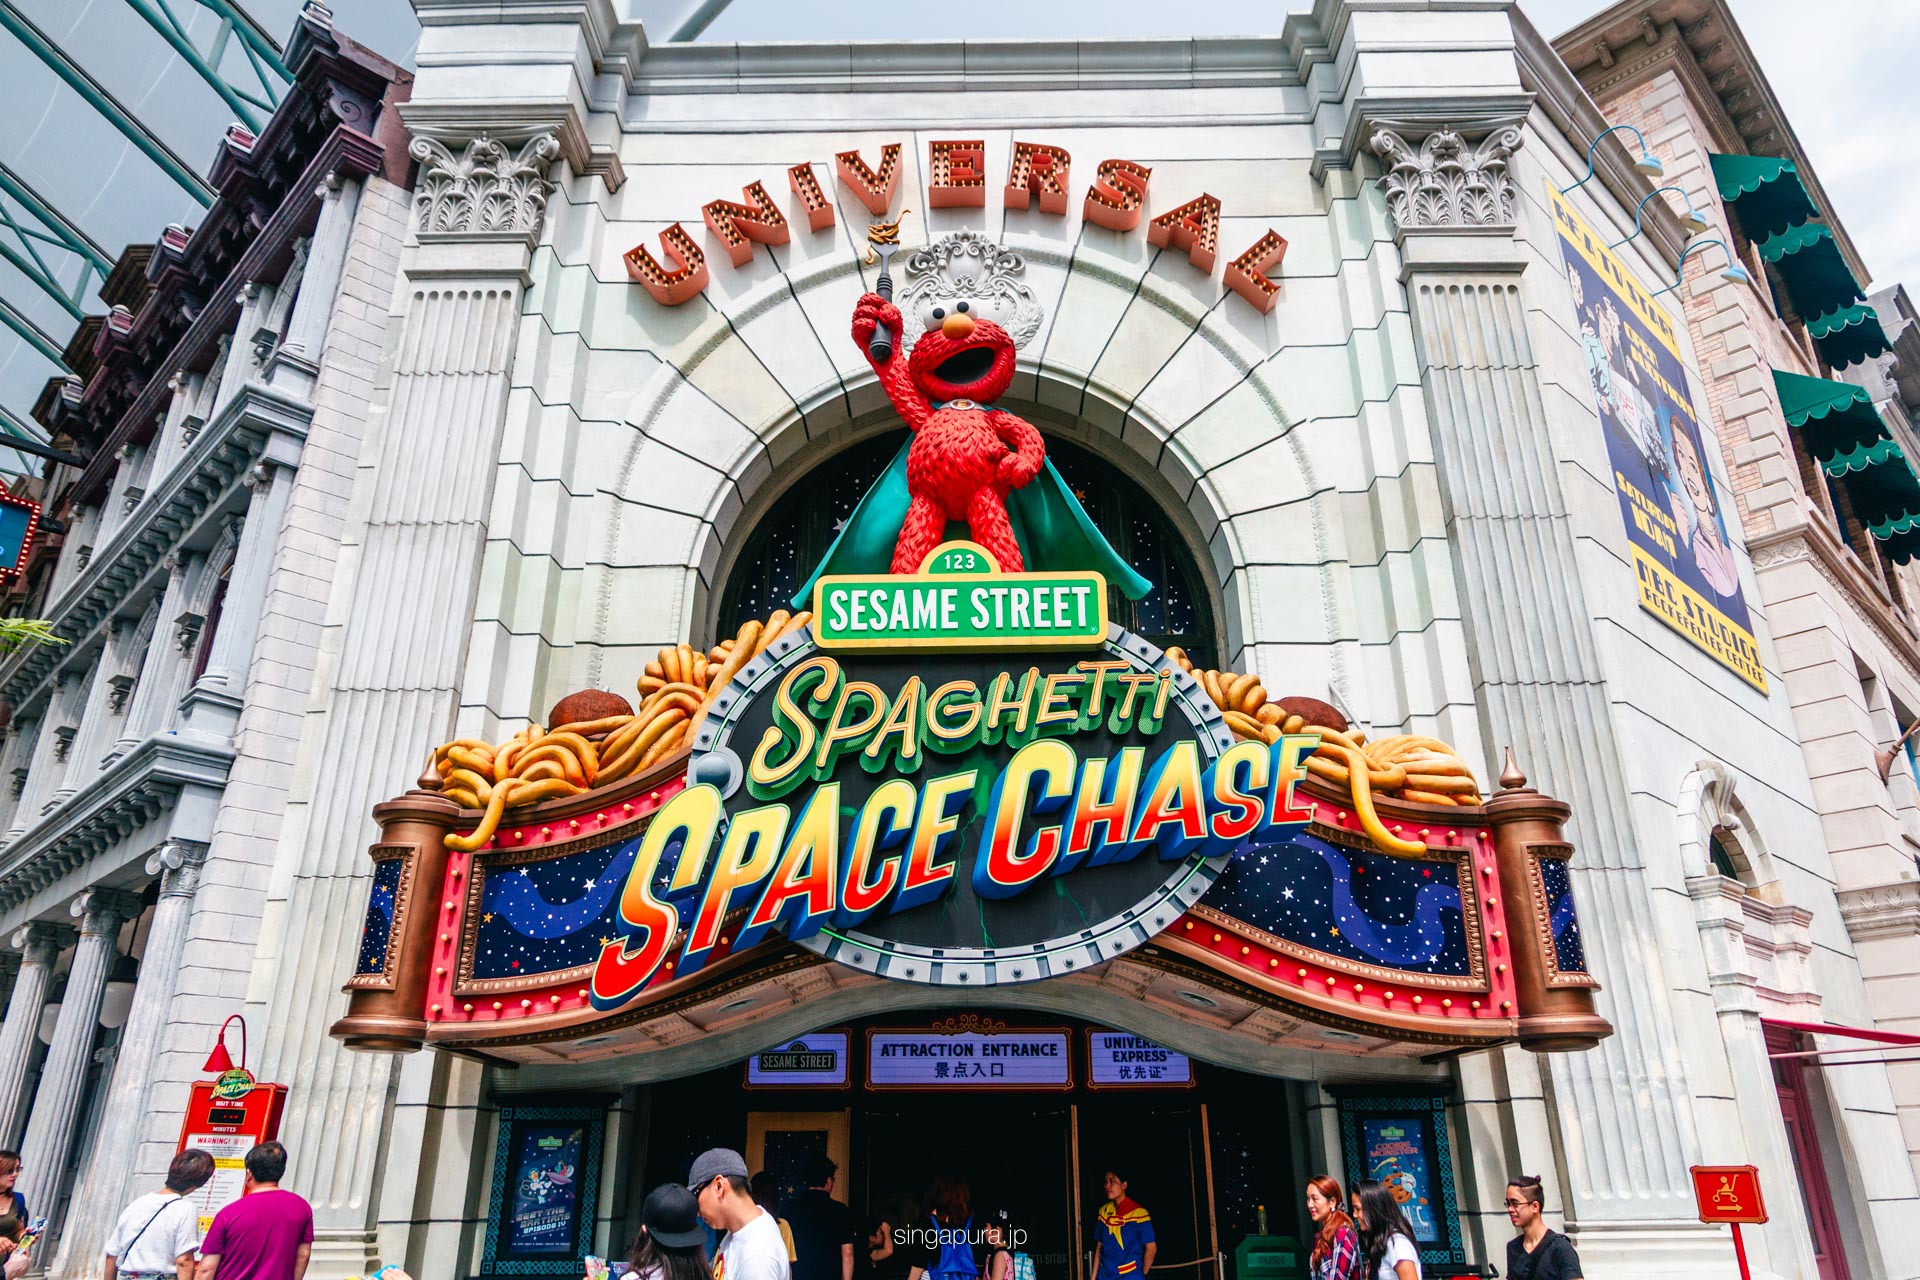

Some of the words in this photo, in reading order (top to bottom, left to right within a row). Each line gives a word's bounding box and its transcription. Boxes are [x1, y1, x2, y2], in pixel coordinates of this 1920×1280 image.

[622, 140, 1288, 314] UNIVERSAL
[1553, 198, 1581, 241] BE
[1584, 232, 1596, 259] A
[1597, 248, 1623, 288] TV
[1623, 321, 1659, 369] OPEN
[1616, 470, 1677, 535] SATURDAY
[944, 554, 975, 569] 123
[829, 588, 959, 631] SESAME
[970, 586, 1091, 630] STREET
[1636, 557, 1677, 606] NBC
[1682, 593, 1761, 668] STUDIOS
[1644, 586, 1723, 655] ROCKEFELLER
[1726, 649, 1764, 684] CENTER
[590, 768, 979, 1006] SPACE
[983, 734, 1321, 889] CHASE
[763, 1055, 798, 1068] SESAME
[800, 1055, 832, 1068] STREET
[880, 1043, 974, 1057] ATTRACTION
[982, 1043, 1058, 1057] ENTRANCE
[1104, 1037, 1163, 1049] UNIVER
[934, 1061, 1004, 1078] 景点入口
[1370, 1147, 1418, 1157] MONSTER
[523, 1224, 557, 1233] EPISODE
